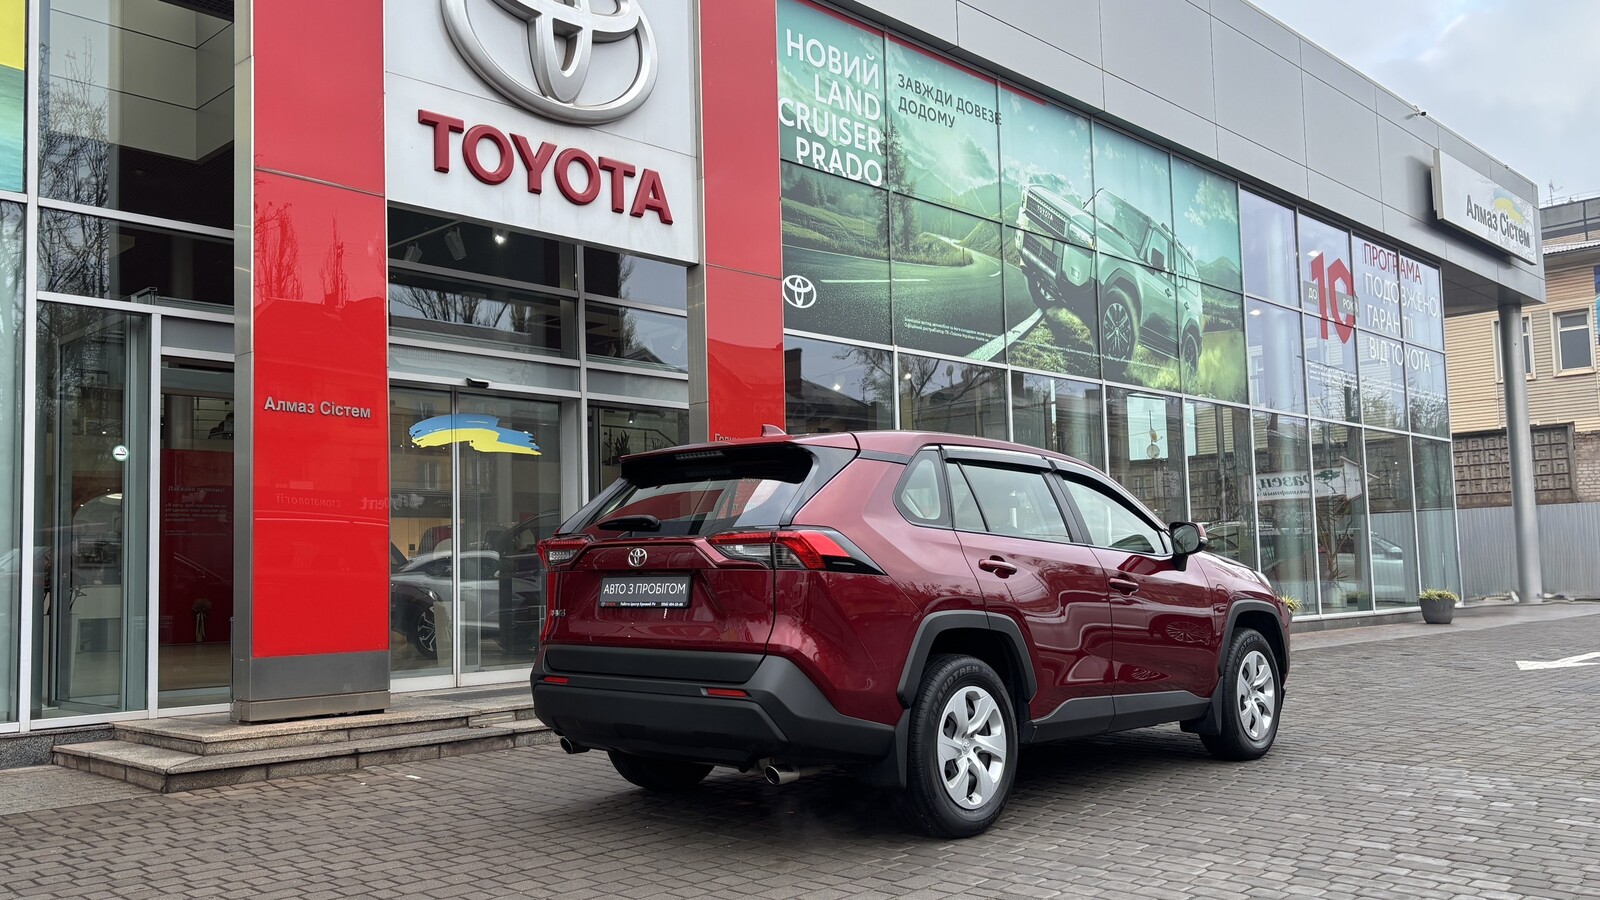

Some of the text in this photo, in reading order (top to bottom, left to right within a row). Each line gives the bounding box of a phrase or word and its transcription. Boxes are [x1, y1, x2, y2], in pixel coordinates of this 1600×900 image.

[786, 29, 880, 90] НОВИЙ
[814, 74, 881, 121] LAND
[897, 74, 1002, 126] ЗАВЖДИ ДОВЕЗЕ
[897, 97, 956, 128] ДОДОМУ
[778, 97, 882, 156] CRUISER
[417, 109, 673, 225] TOYOTA
[796, 137, 883, 187] PRADO
[1466, 194, 1531, 249] Алмаз Сістем
[1363, 242, 1422, 285] ПРОГРАМА
[1308, 288, 1317, 300] ДО
[1311, 252, 1356, 344] 10
[1366, 304, 1414, 339] ГАРАНТІЇ
[1369, 337, 1389, 367] ВІД
[263, 396, 372, 420] Алмаз Сістем
[603, 583, 686, 595] АВТО З ПРОБІГОМ
